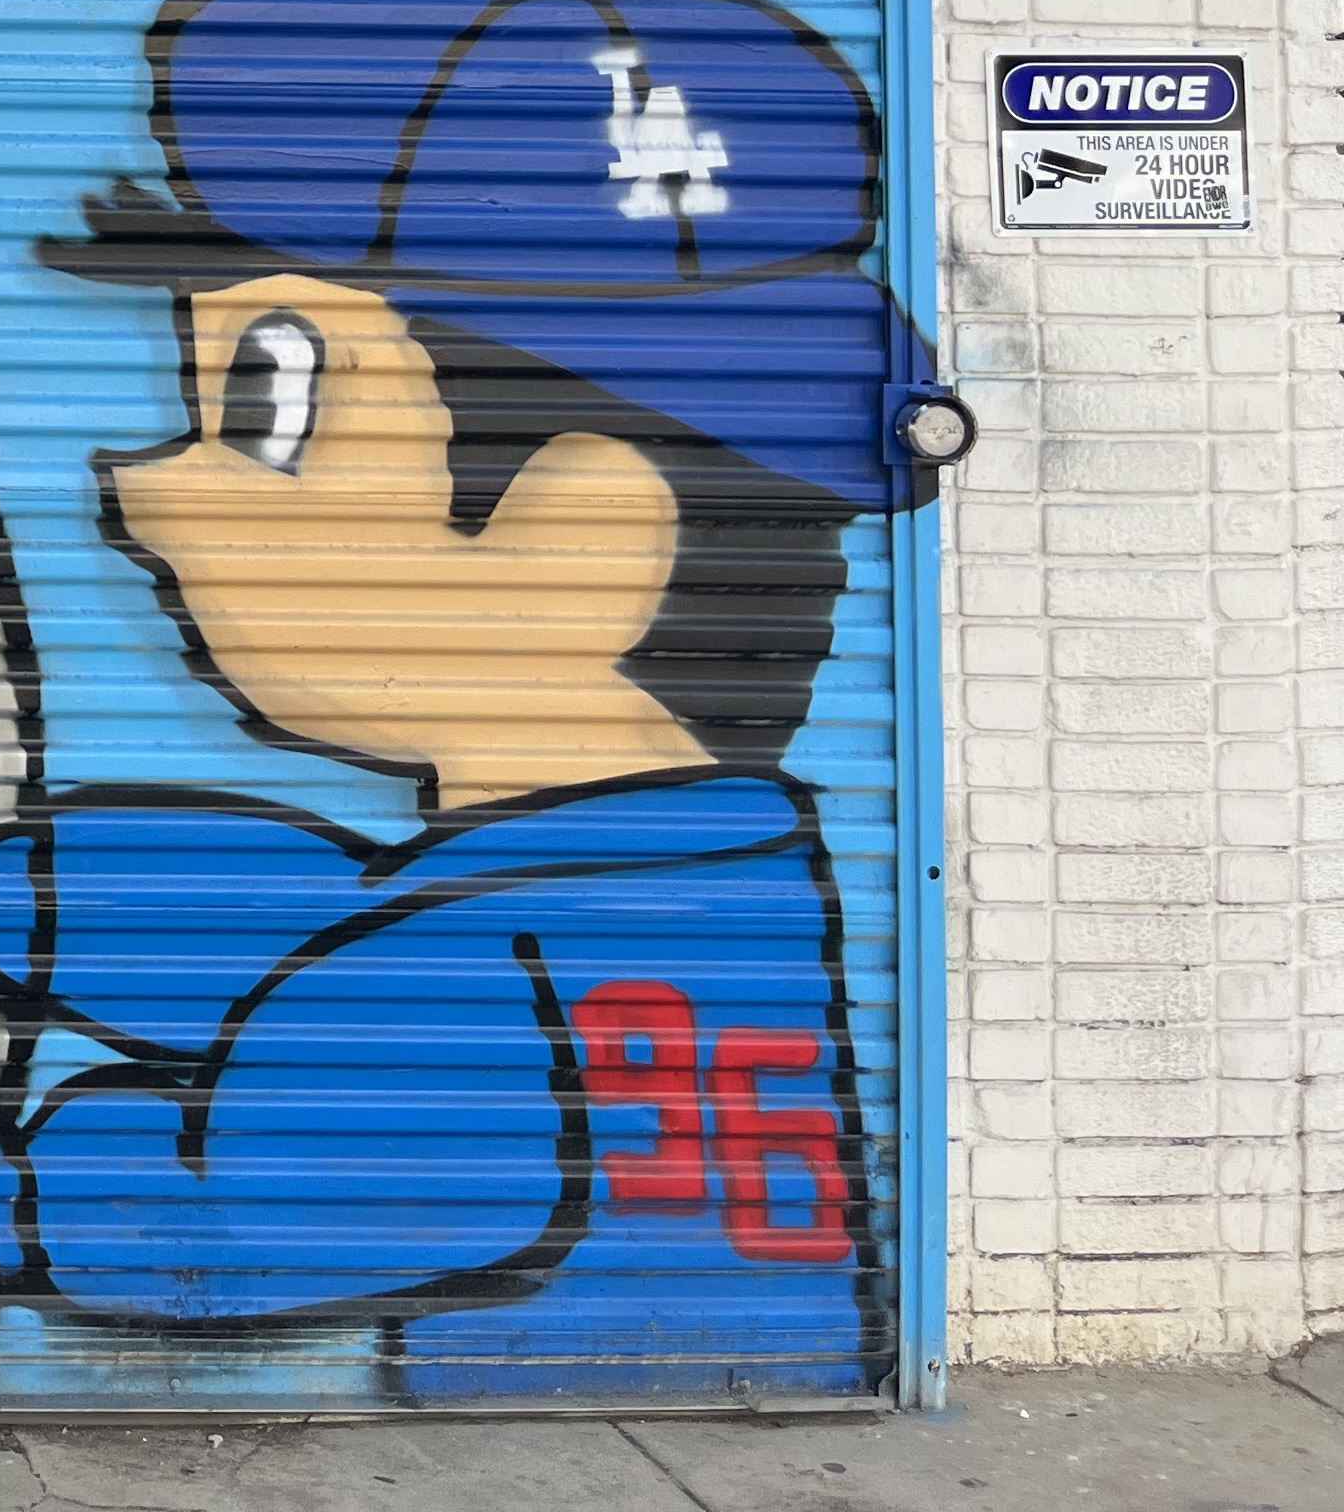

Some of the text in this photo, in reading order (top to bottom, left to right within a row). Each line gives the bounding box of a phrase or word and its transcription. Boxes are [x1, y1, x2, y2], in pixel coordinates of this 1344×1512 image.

[1028, 75, 1210, 111] NOTICE
[592, 46, 730, 220] LA
[1076, 136, 1229, 151] THIS AREA IS UNDER
[1134, 154, 1230, 176] 24 HOUR
[570, 980, 854, 1263] 96
